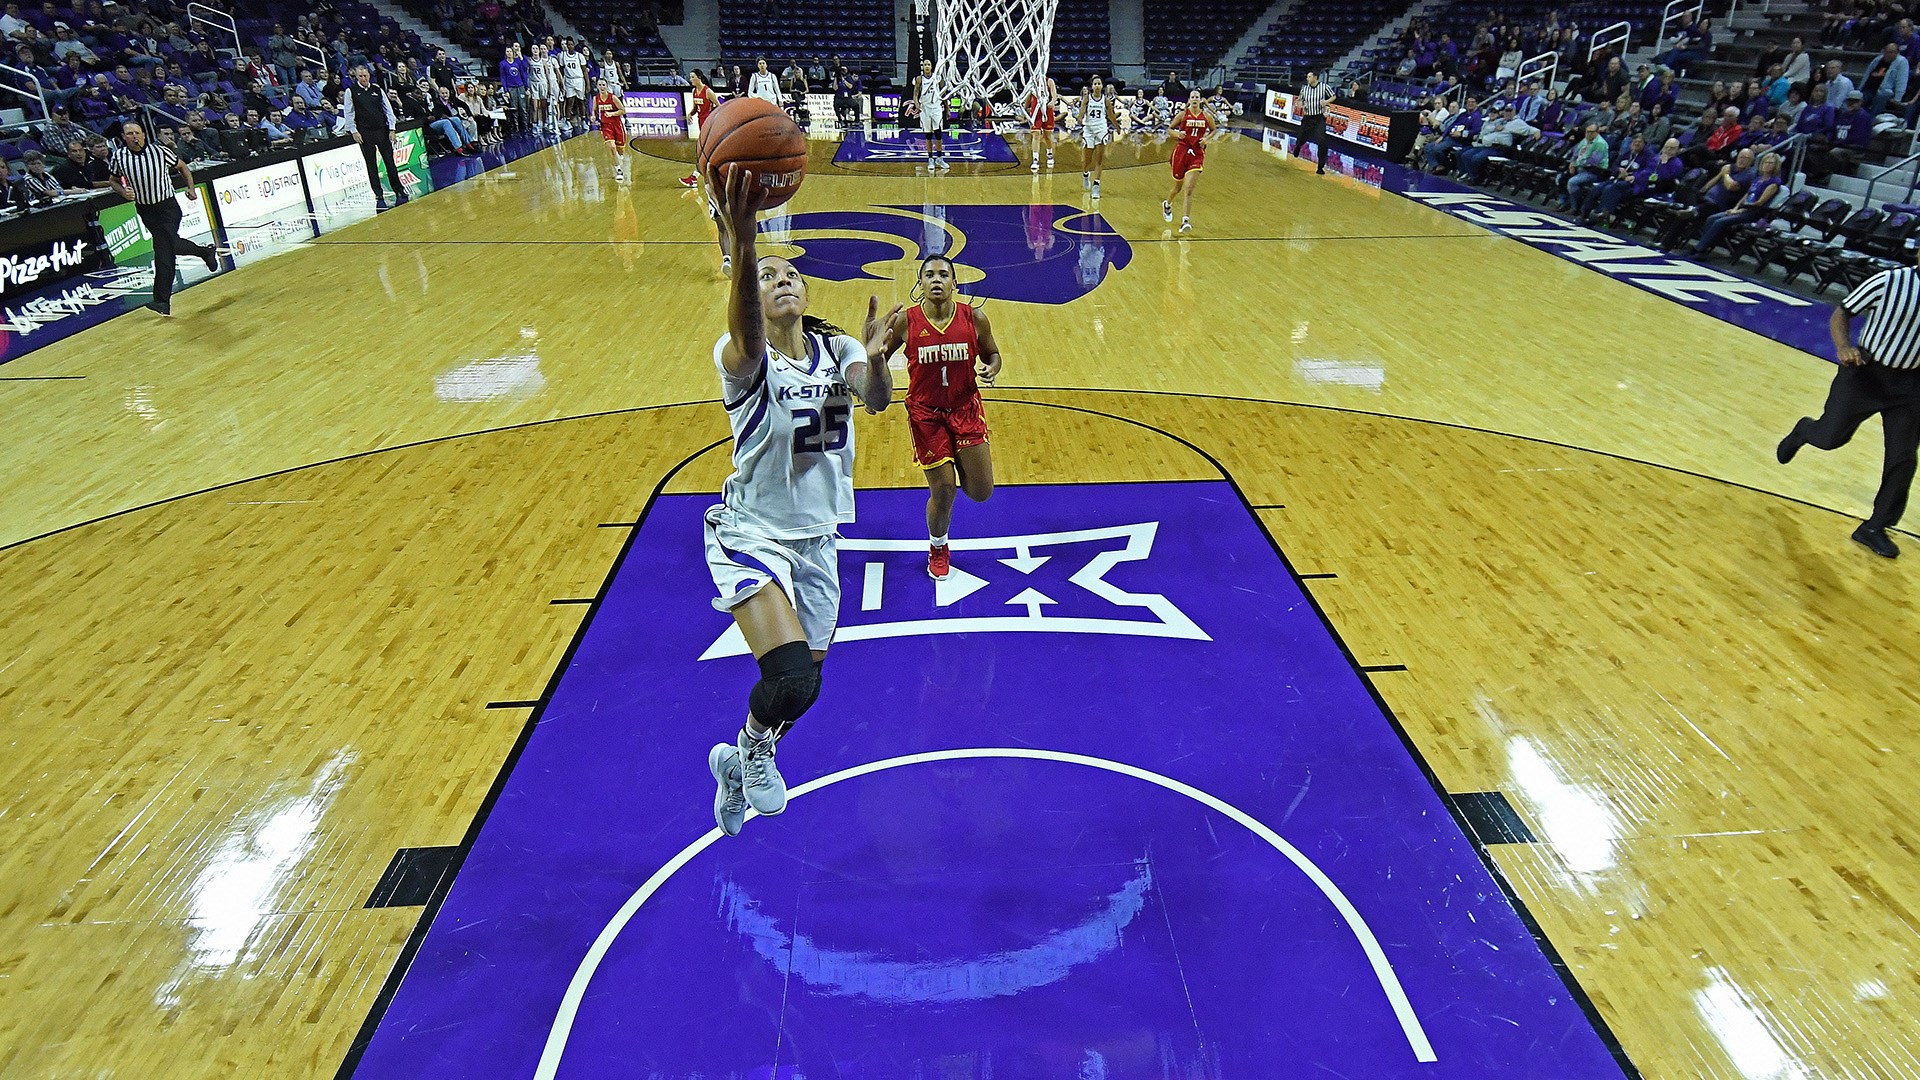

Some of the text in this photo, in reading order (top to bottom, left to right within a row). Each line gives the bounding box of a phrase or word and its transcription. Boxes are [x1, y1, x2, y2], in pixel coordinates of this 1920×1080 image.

[1089, 109, 1101, 118] 43
[1191, 127, 1198, 137] 11
[326, 165, 340, 179] Via
[219, 184, 251, 206] POINTE
[262, 173, 300, 198] DISTRICT
[104, 225, 124, 246] WITH
[122, 216, 138, 235] YOU
[1401, 191, 1813, 306] K-STATE
[0, 239, 88, 294] Pizza Hut
[918, 343, 969, 364] PITT STATE
[940, 366, 949, 387] 1
[779, 383, 849, 401] K-STATE
[791, 404, 849, 454] 25
